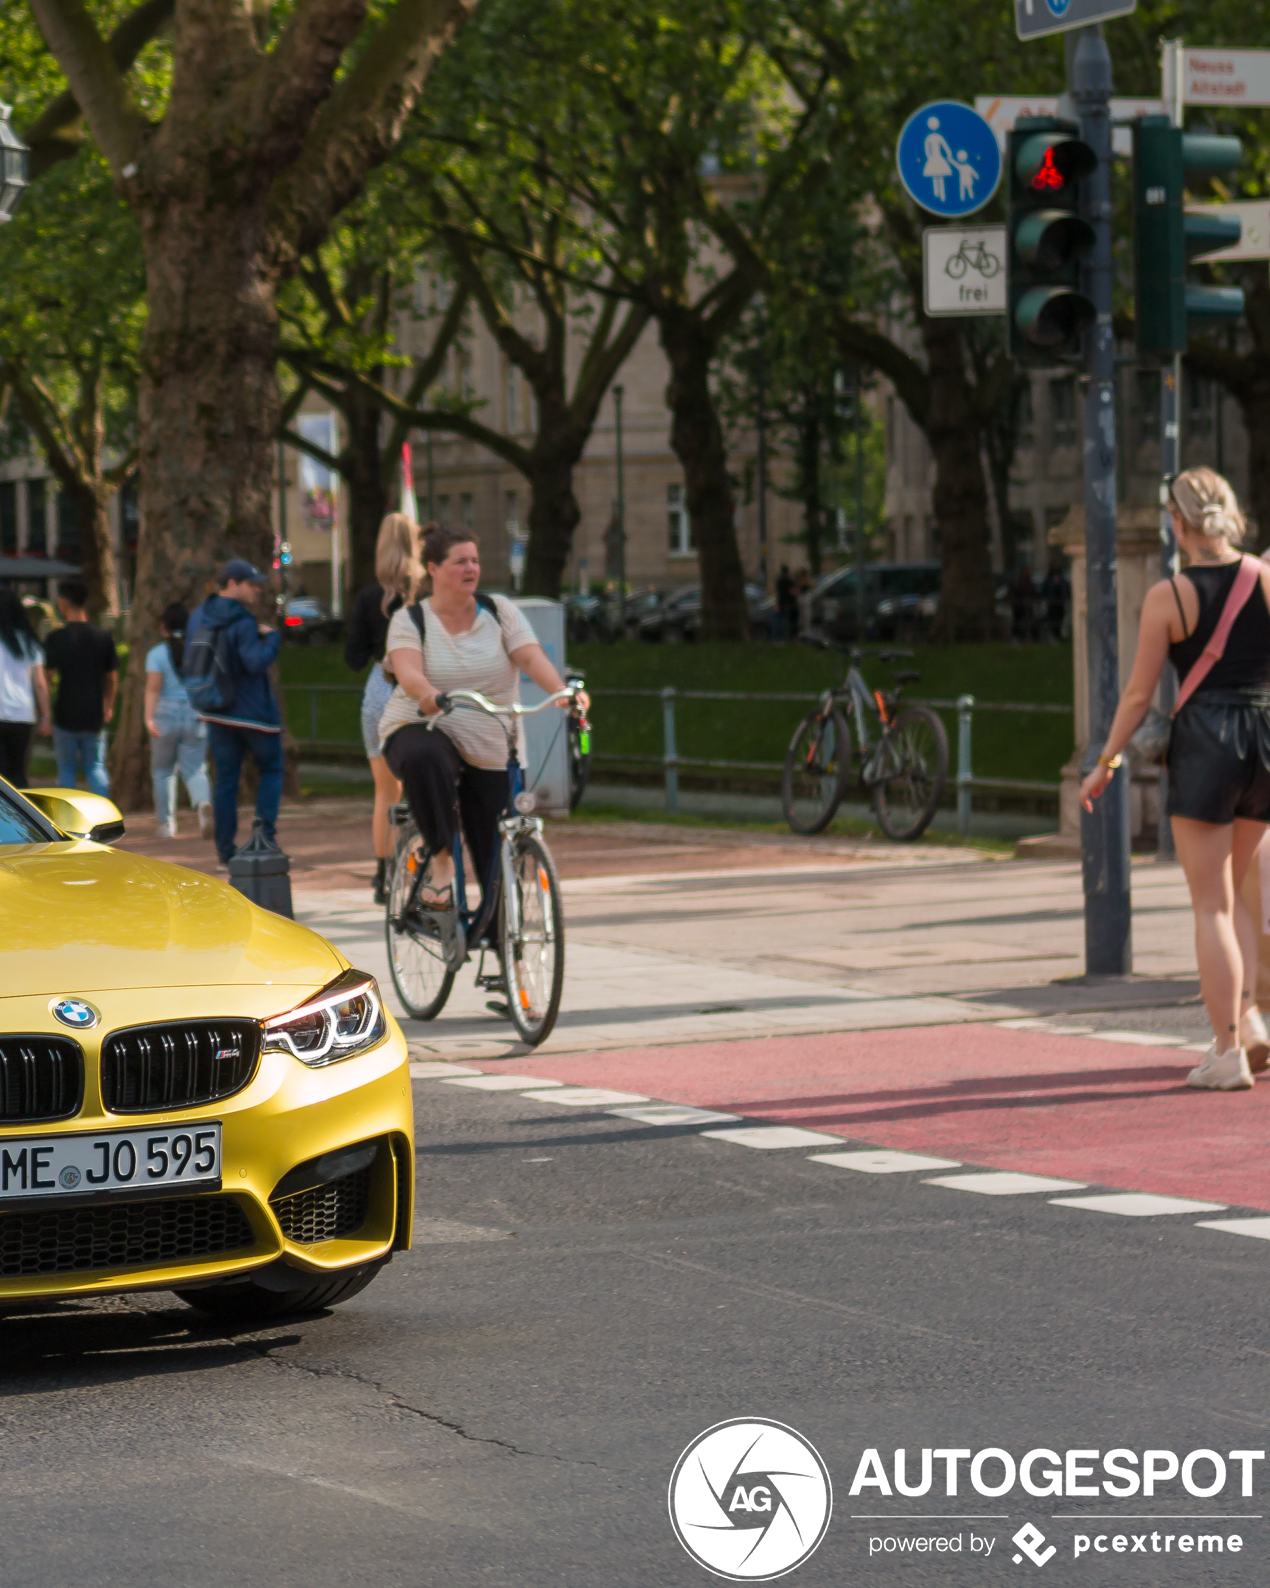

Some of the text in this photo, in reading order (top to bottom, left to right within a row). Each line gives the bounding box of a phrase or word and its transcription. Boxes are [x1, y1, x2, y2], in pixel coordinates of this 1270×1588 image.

[959, 283, 988, 301] frei
[2, 1146, 56, 1191] ME
[86, 1139, 137, 1184] JO
[147, 1131, 216, 1178] 595
